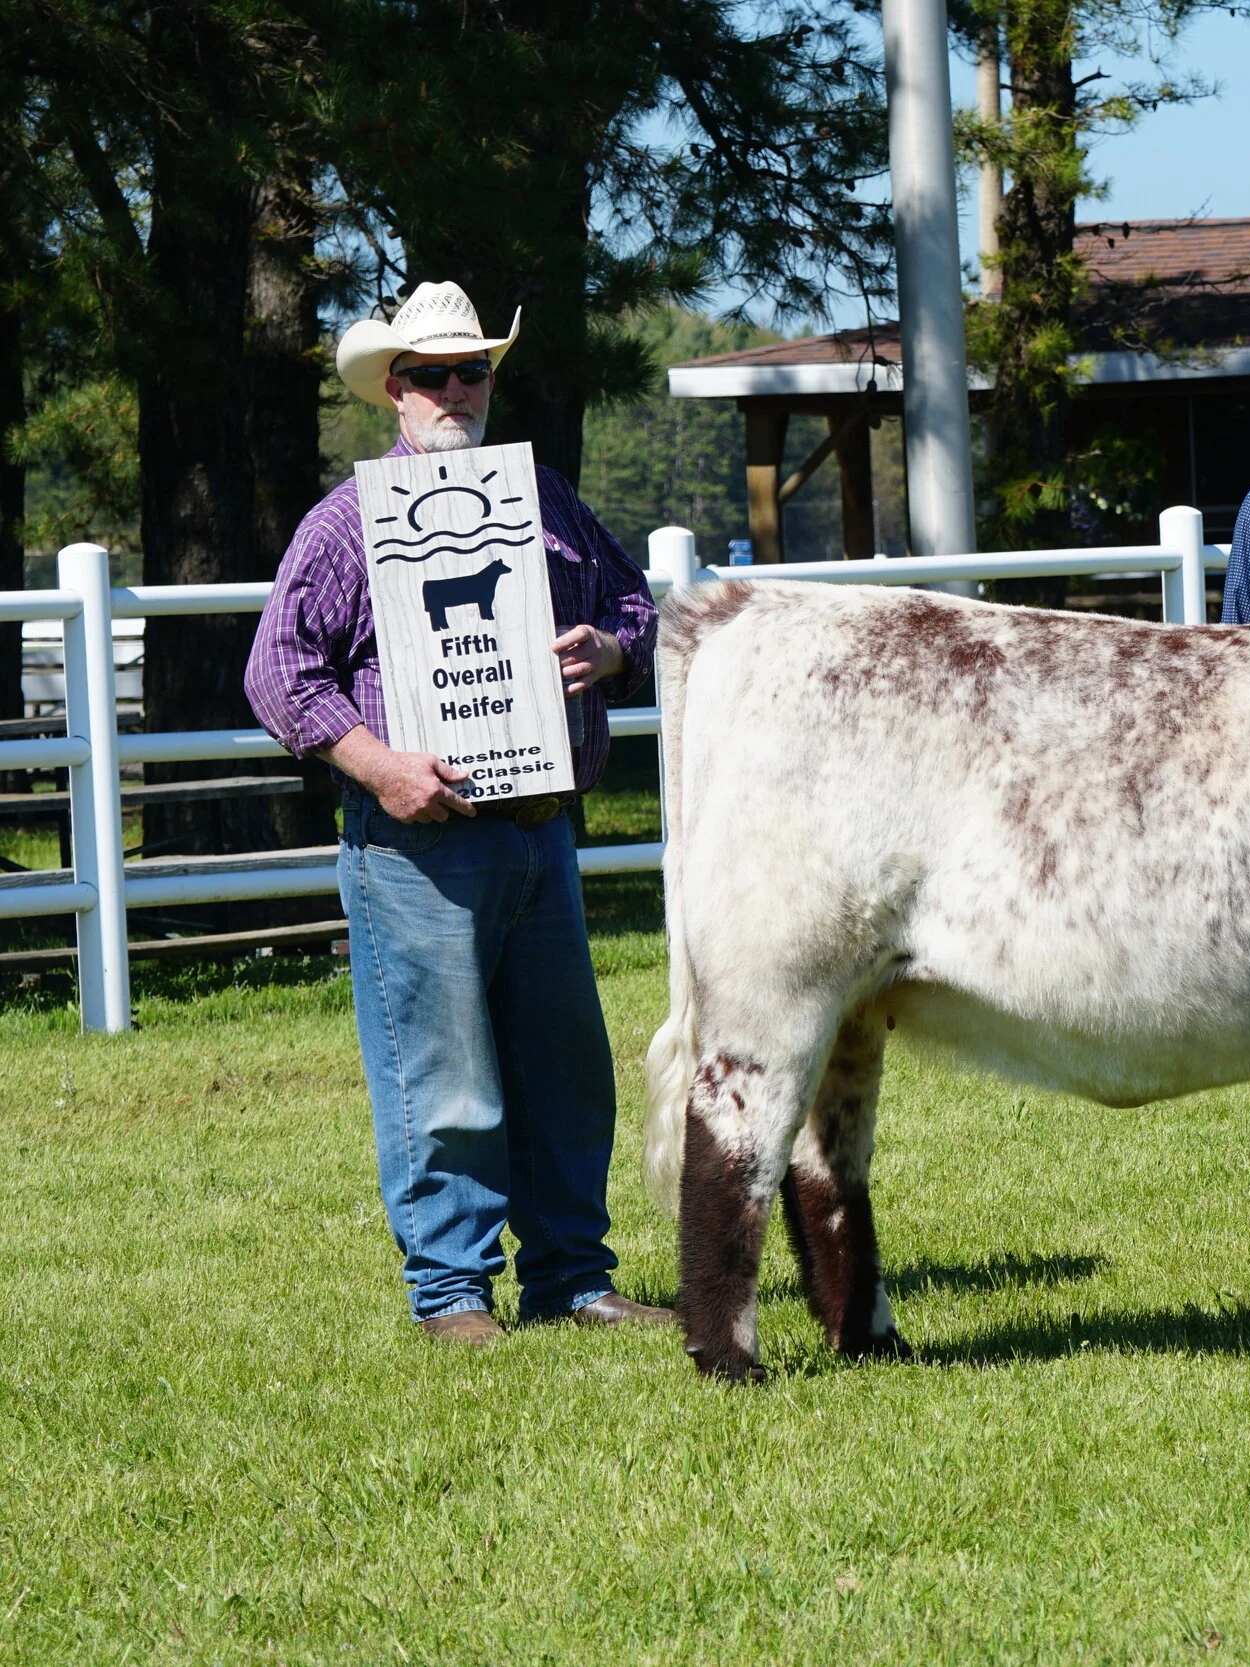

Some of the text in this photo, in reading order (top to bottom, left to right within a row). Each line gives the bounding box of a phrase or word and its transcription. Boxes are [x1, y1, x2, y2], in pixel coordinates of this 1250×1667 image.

[441, 633, 498, 658] Fifth
[432, 659, 513, 690] Overall
[440, 696, 514, 722] Heifer
[440, 746, 542, 766] keshore
[471, 760, 555, 780] Classic
[456, 782, 513, 799] 2019
